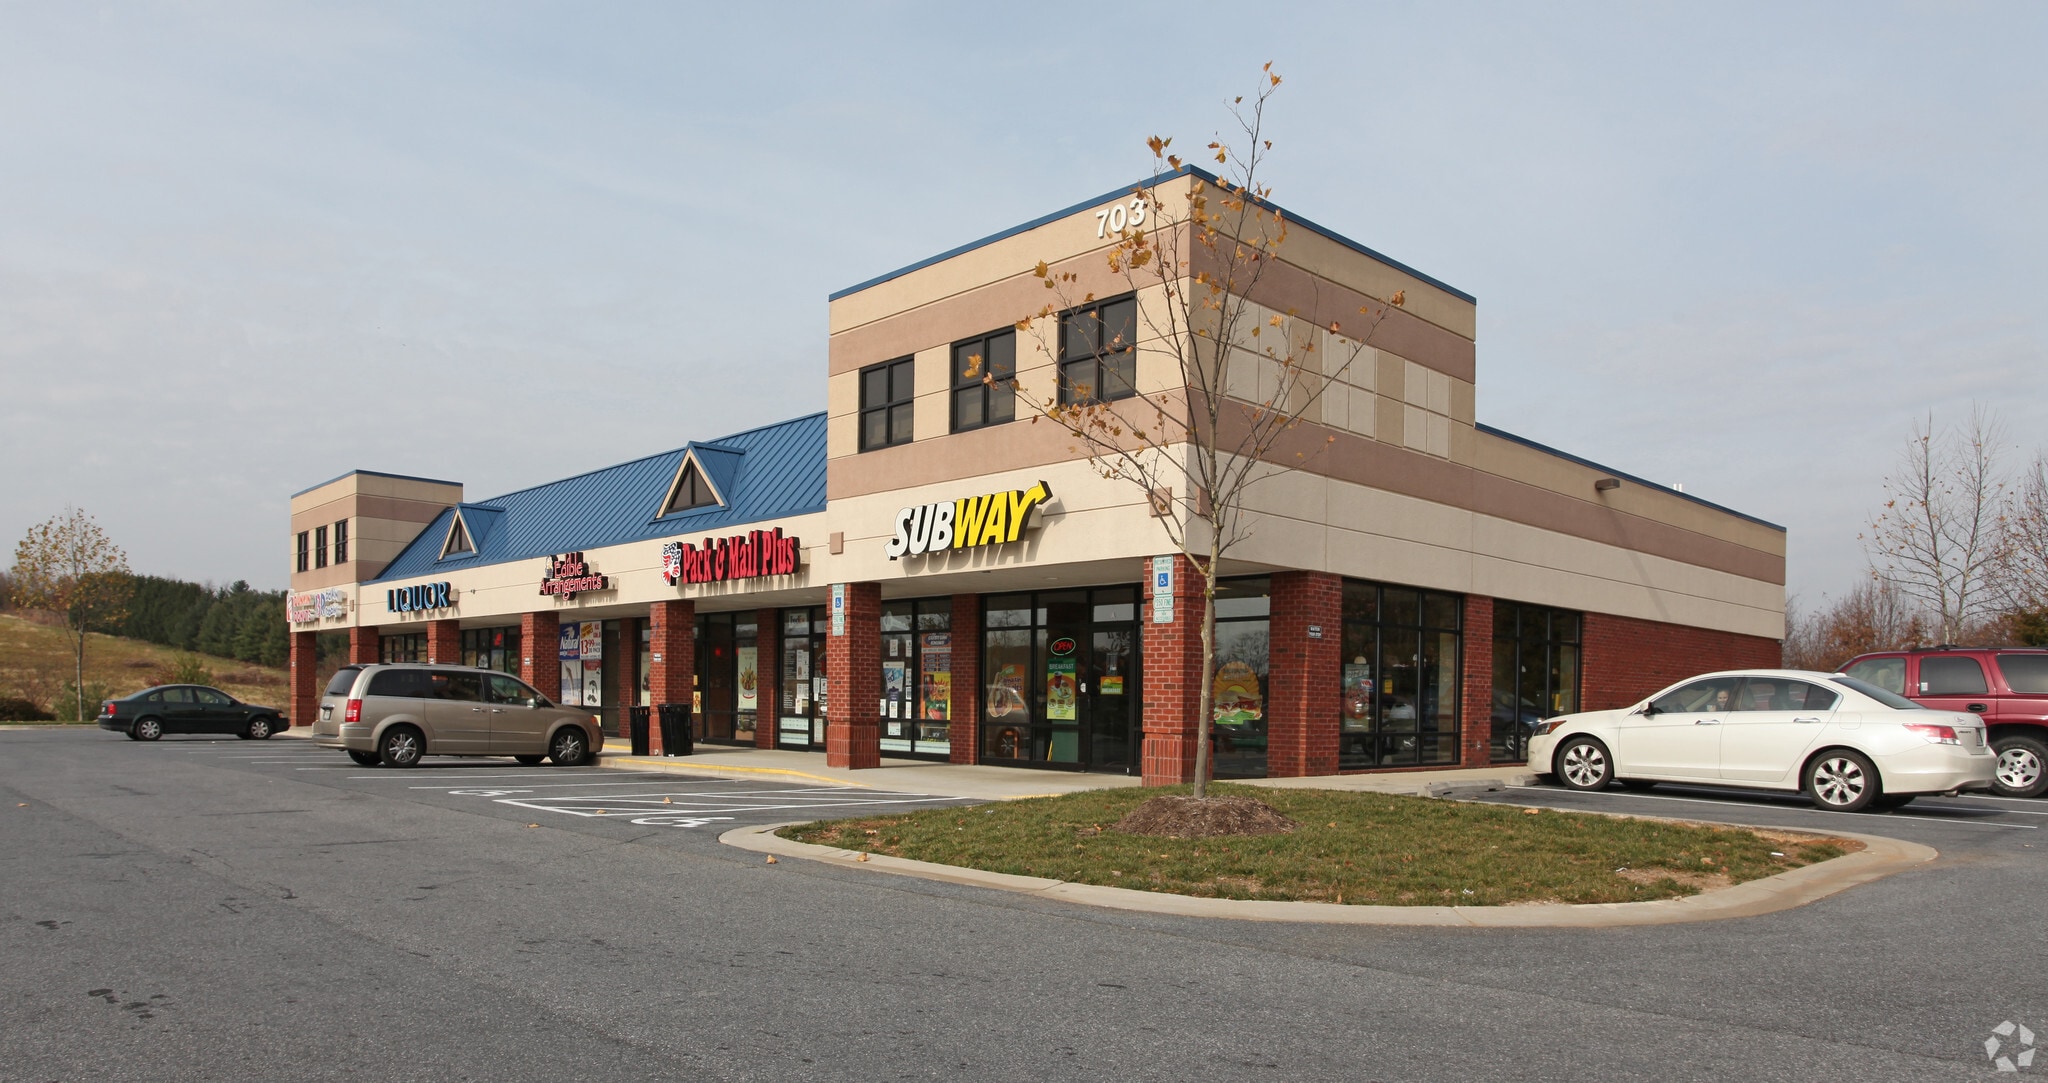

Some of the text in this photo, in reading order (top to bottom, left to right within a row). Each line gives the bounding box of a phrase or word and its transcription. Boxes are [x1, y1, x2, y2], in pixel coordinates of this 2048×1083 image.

[1096, 197, 1145, 238] 703
[884, 480, 1047, 558] SUBWAY
[554, 551, 583, 579] Edible
[682, 527, 795, 585] Pack & Mail Plus
[387, 581, 449, 613] LIQUOR
[540, 573, 603, 601] Arrangements
[1053, 641, 1073, 651] OPEN
